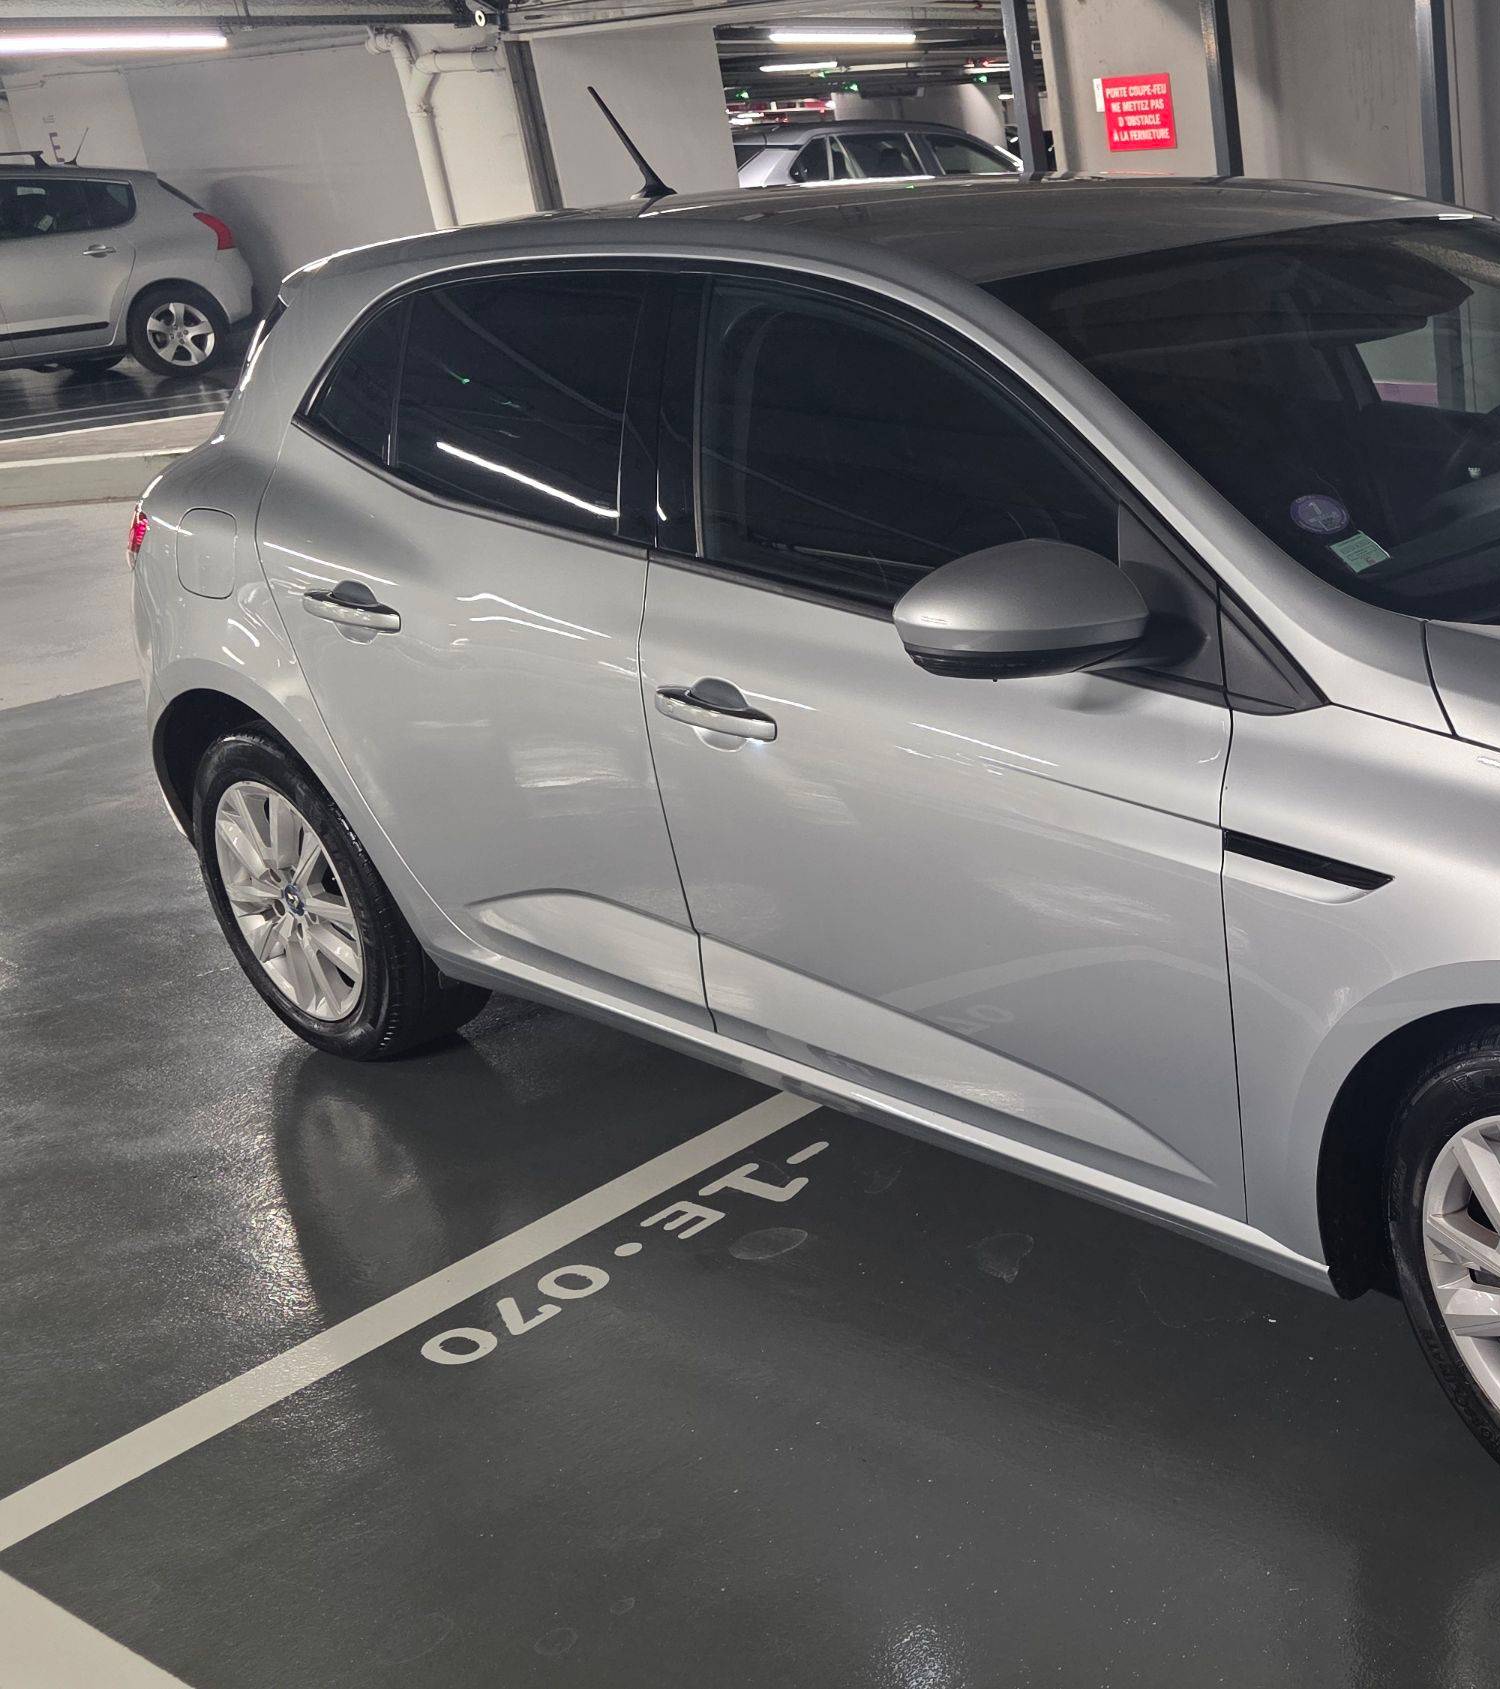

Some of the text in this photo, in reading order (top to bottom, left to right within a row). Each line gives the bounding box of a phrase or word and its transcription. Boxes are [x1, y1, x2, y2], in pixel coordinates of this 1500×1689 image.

[1128, 83, 1166, 97] COUPE-FEU
[1122, 100, 1149, 112] METTEZ
[1150, 98, 1165, 110] PAS
[1120, 131, 1130, 142] LA
[1130, 128, 1170, 141] FERMETURE
